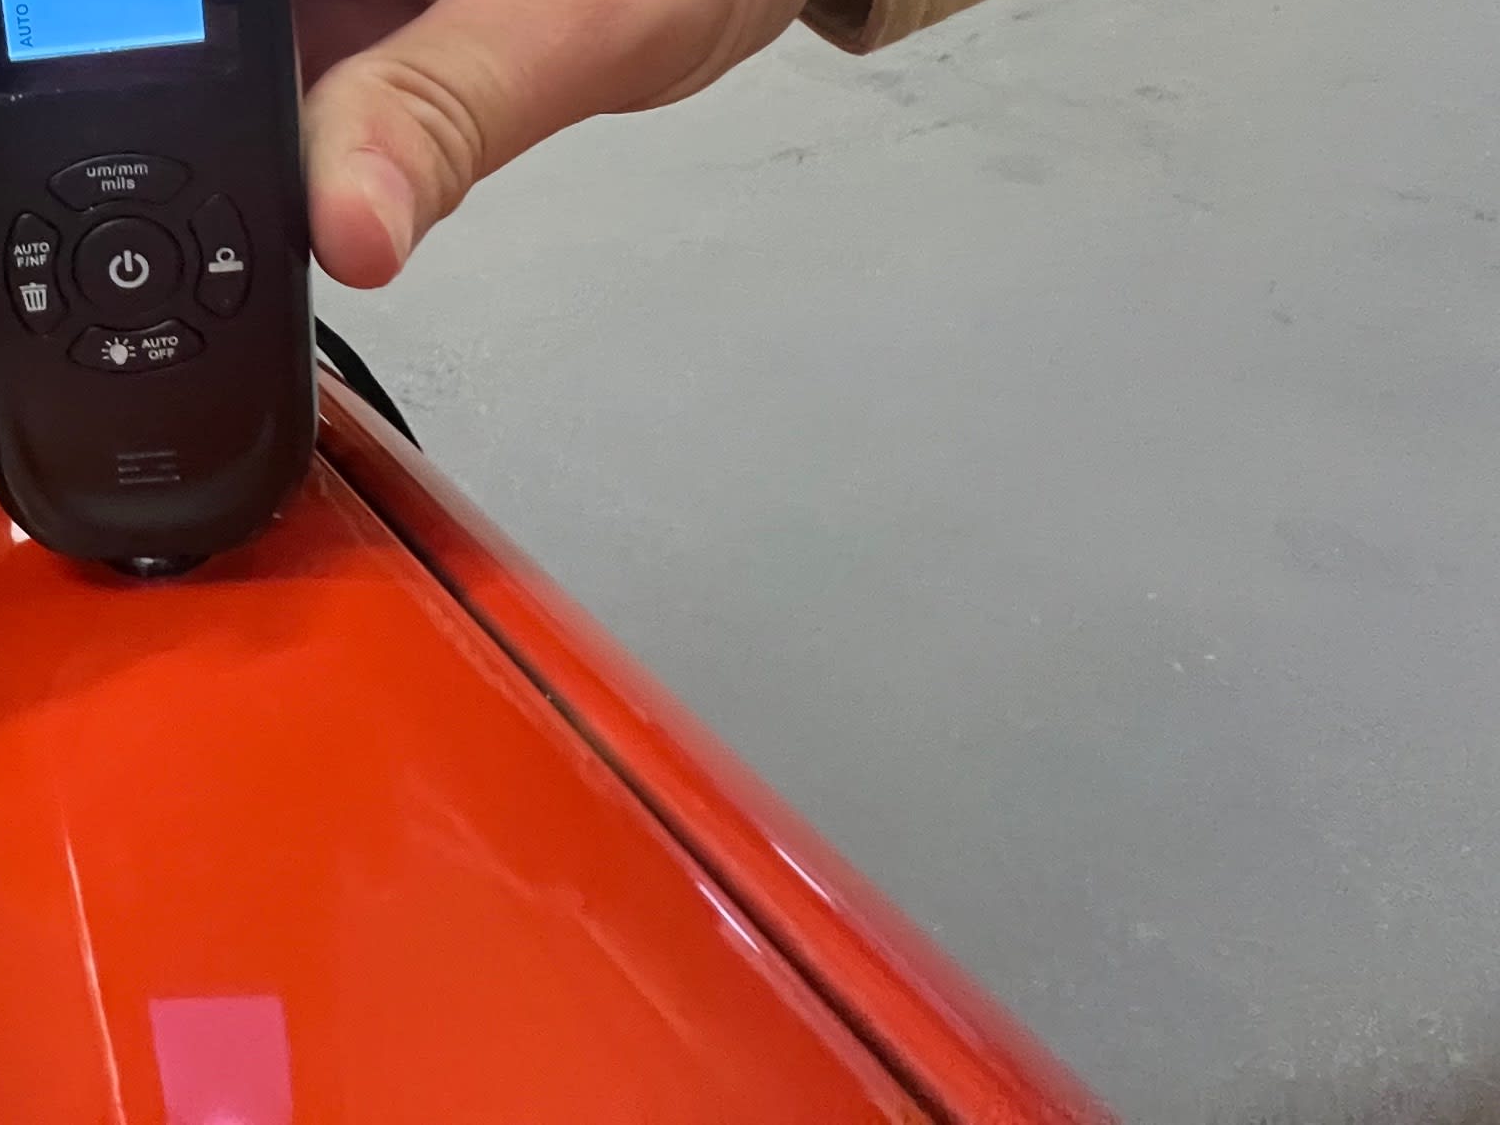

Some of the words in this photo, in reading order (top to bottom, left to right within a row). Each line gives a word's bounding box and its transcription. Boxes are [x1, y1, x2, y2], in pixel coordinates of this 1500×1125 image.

[16, 3, 33, 48] AUTO
[86, 163, 149, 178] um/mm
[101, 177, 136, 191] mils
[13, 242, 50, 256] AUTO
[17, 254, 48, 268] F/NF
[141, 336, 179, 349] AUTO
[149, 348, 176, 360] OFF
